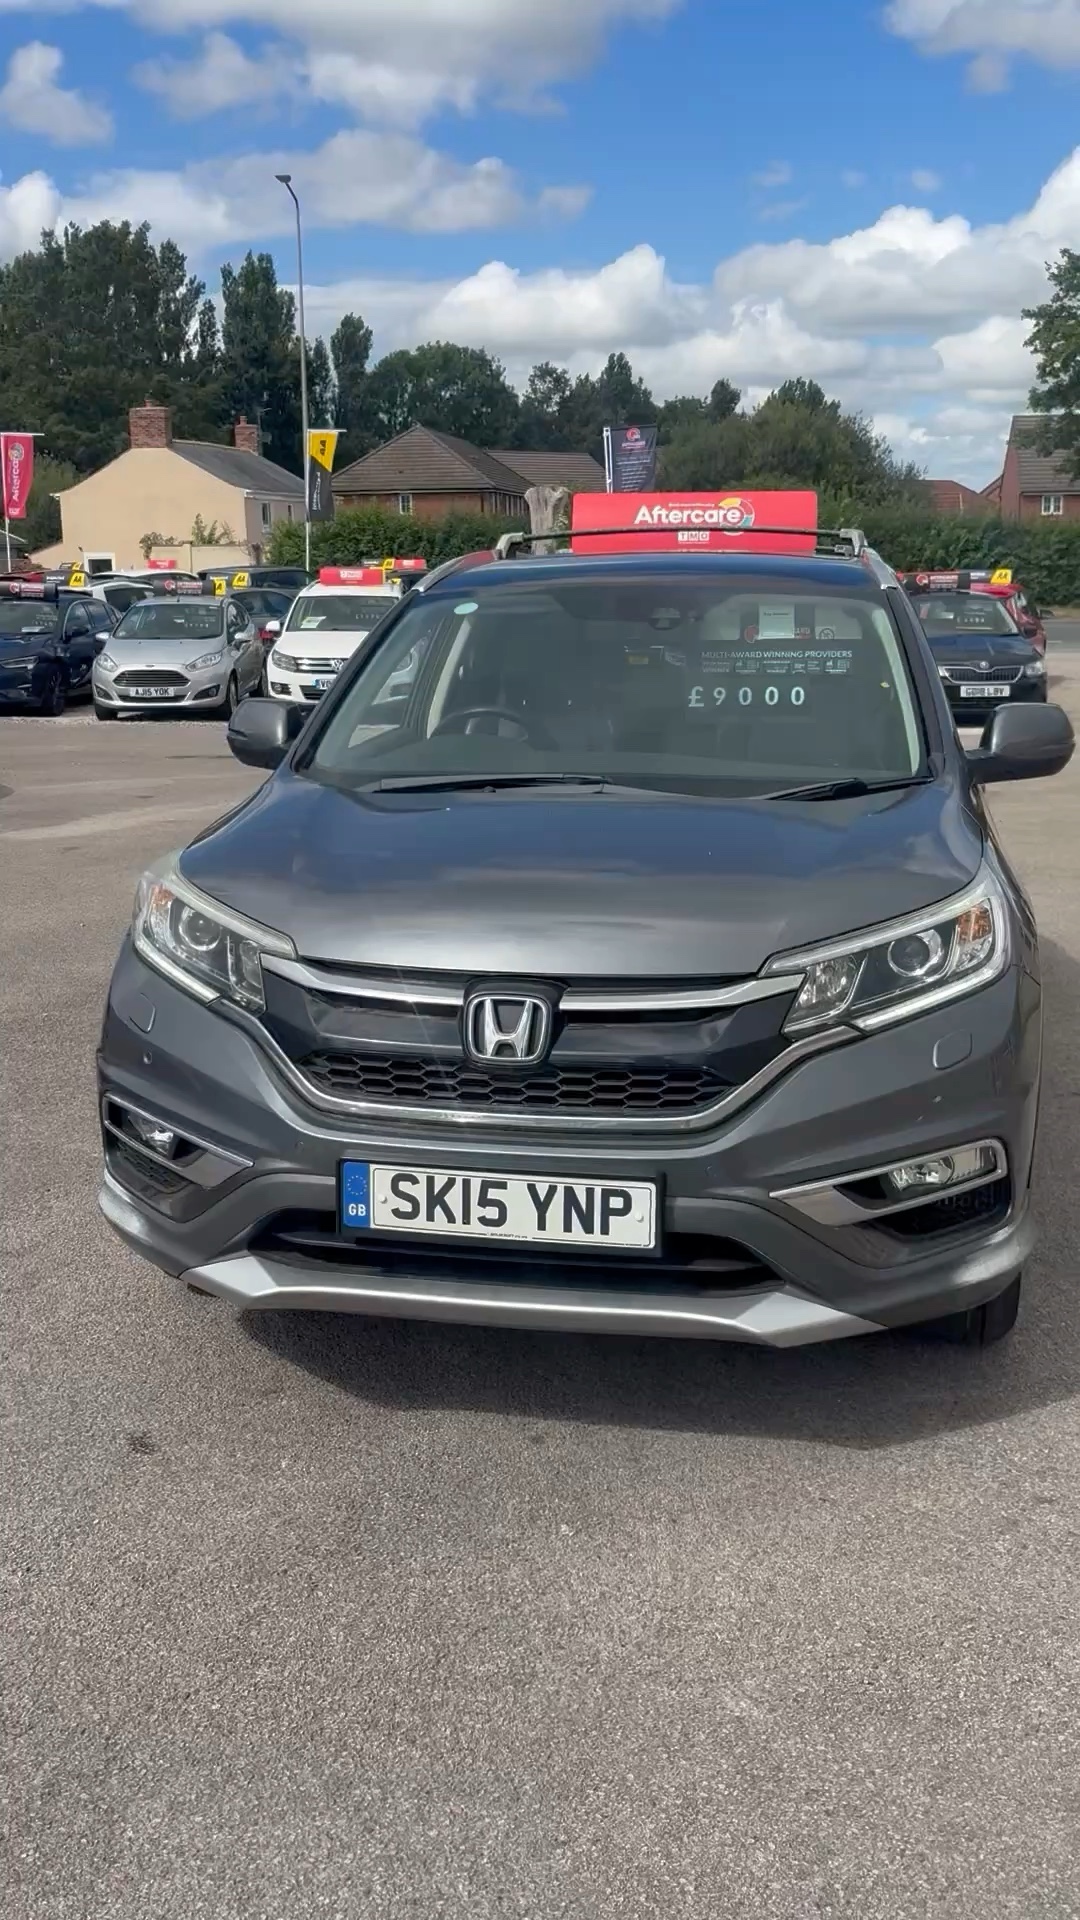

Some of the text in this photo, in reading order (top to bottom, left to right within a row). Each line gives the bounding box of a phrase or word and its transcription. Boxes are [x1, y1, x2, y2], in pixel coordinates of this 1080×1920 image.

[634, 505, 741, 524] Aftercare
[680, 532, 708, 540] TMO
[804, 650, 852, 658] PROVIDERS
[349, 1203, 366, 1217] GB
[390, 1173, 632, 1236] SK15 YNP
